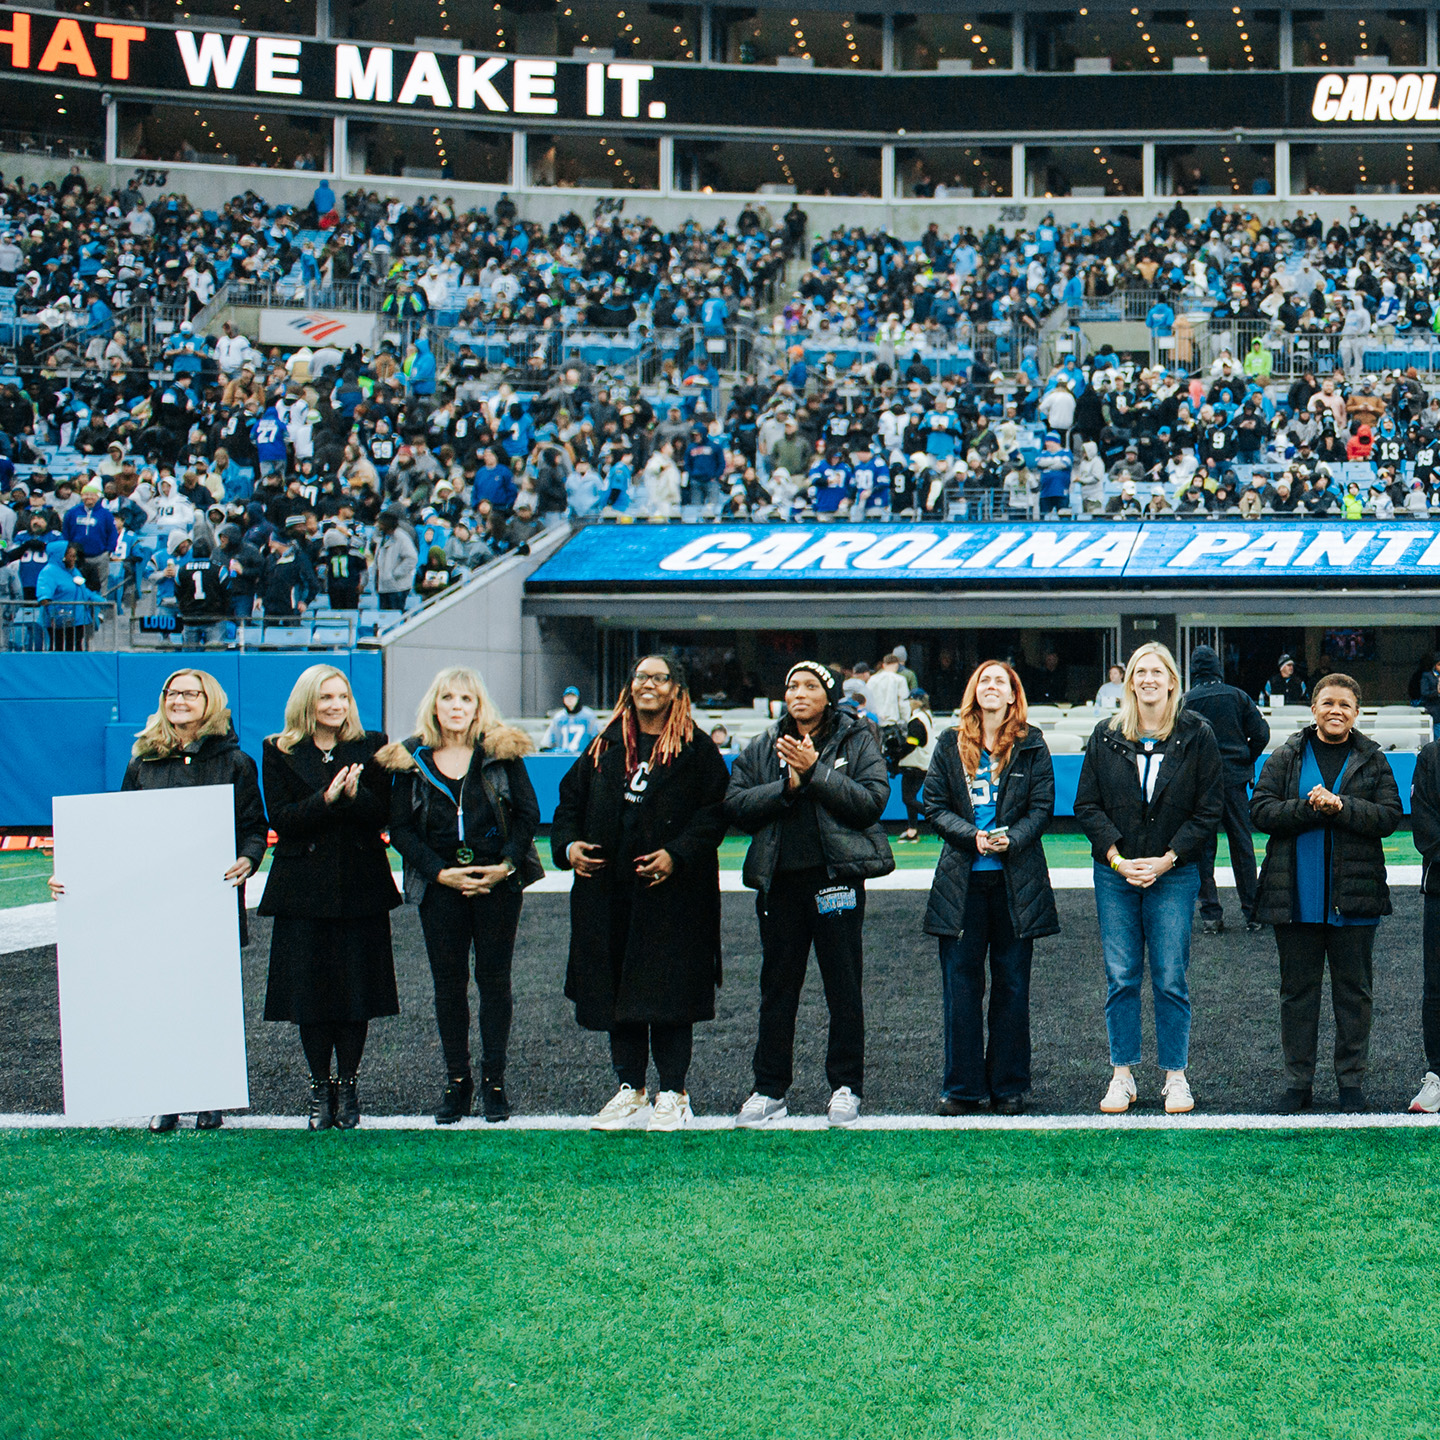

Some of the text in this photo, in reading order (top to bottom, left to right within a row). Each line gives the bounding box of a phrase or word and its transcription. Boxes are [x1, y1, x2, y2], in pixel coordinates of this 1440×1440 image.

[175, 30, 302, 95] WE
[335, 44, 558, 114] MAKE
[586, 61, 666, 119] IT.
[257, 427, 278, 444] 27
[1212, 431, 1226, 449] 9
[1380, 442, 1400, 461] 13
[894, 474, 906, 494] 9
[658, 531, 1149, 571] CAROLINA
[330, 554, 350, 579] 11
[192, 570, 207, 600] 1
[143, 616, 176, 630] LOUD
[561, 723, 586, 751] 17
